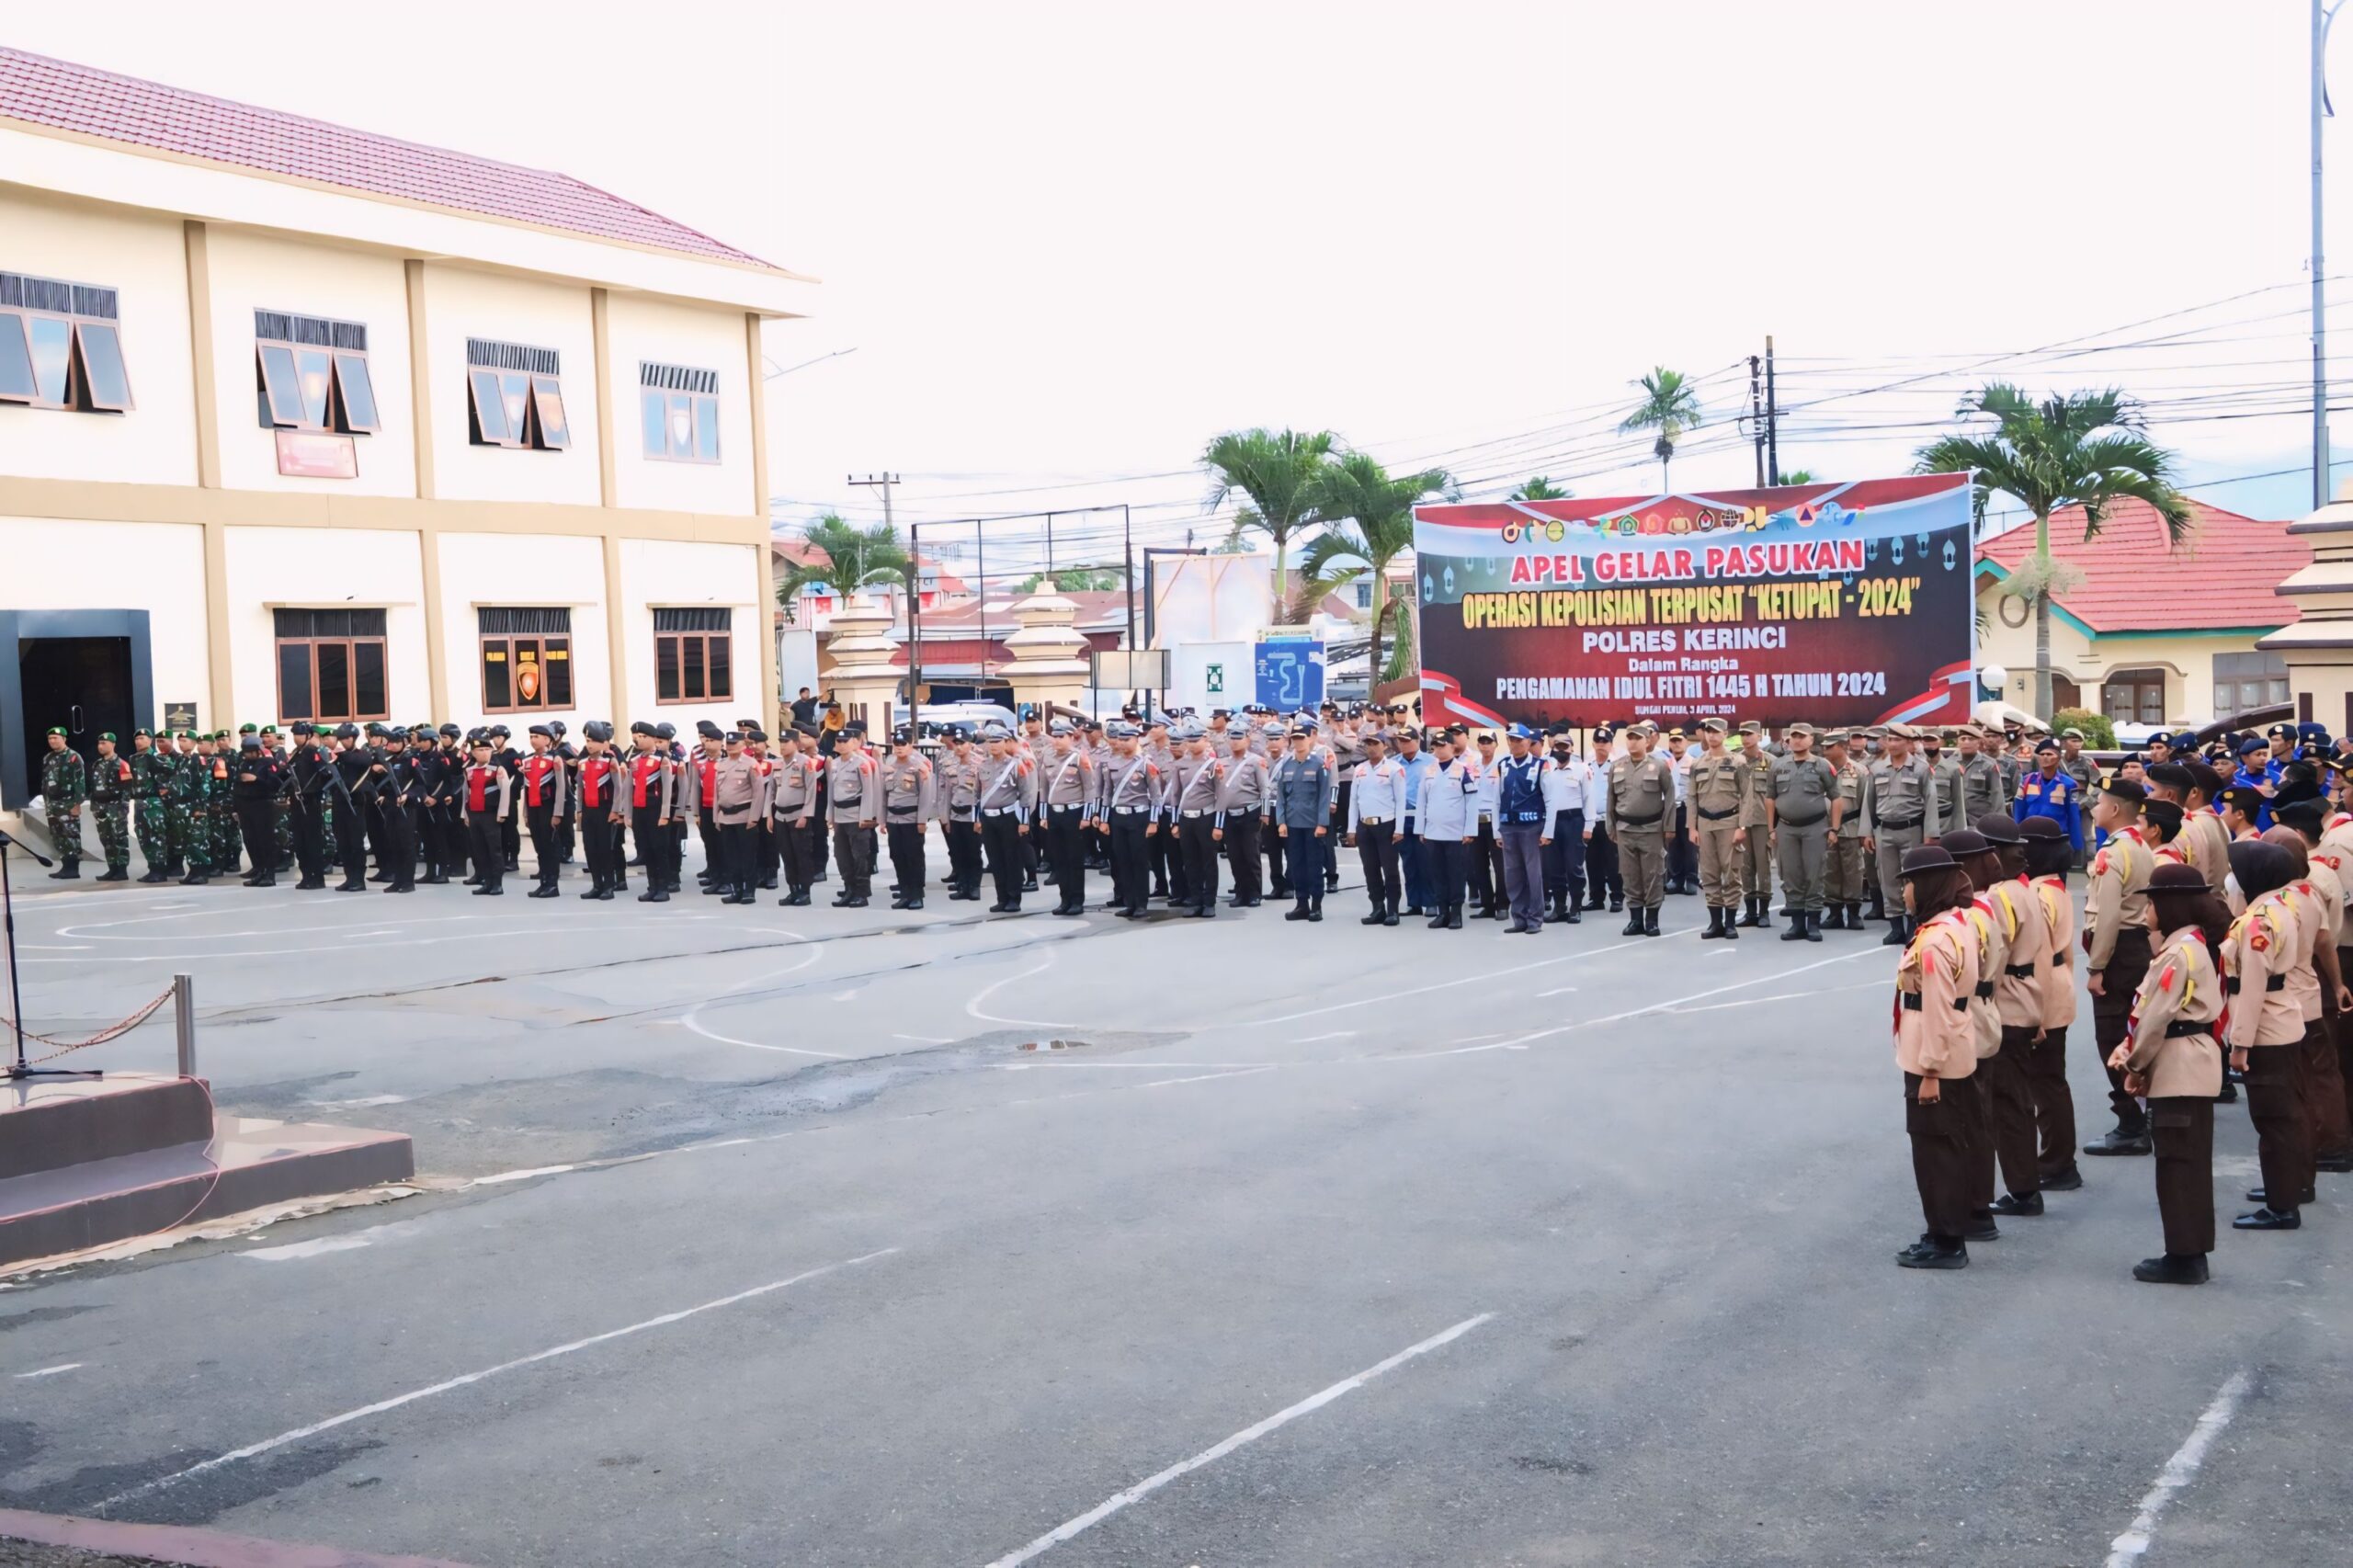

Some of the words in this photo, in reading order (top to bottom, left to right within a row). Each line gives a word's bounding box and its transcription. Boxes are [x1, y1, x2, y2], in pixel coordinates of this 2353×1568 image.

[1510, 554, 1586, 585] APEL
[1594, 549, 1696, 581] GELAR
[1704, 539, 1865, 578] PASUKAN
[1462, 591, 1537, 630] OPERASI
[1540, 589, 1646, 628] KEPOLISIAN
[1650, 585, 1745, 625] TERPUSAT
[1583, 630, 1677, 653] POLRES
[1684, 626, 1786, 651] KERINCI
[1629, 658, 1677, 672] Dalam
[1680, 656, 1738, 674] Rangka
[1496, 676, 1609, 699] PENGAMANAN
[1614, 676, 1654, 699] IDUL
[1657, 676, 1702, 699] FITRI
[1706, 674, 1751, 698] 1445
[1755, 674, 1768, 697] H
[1771, 673, 1833, 697] TAHUN
[1837, 671, 1886, 697] 2024
